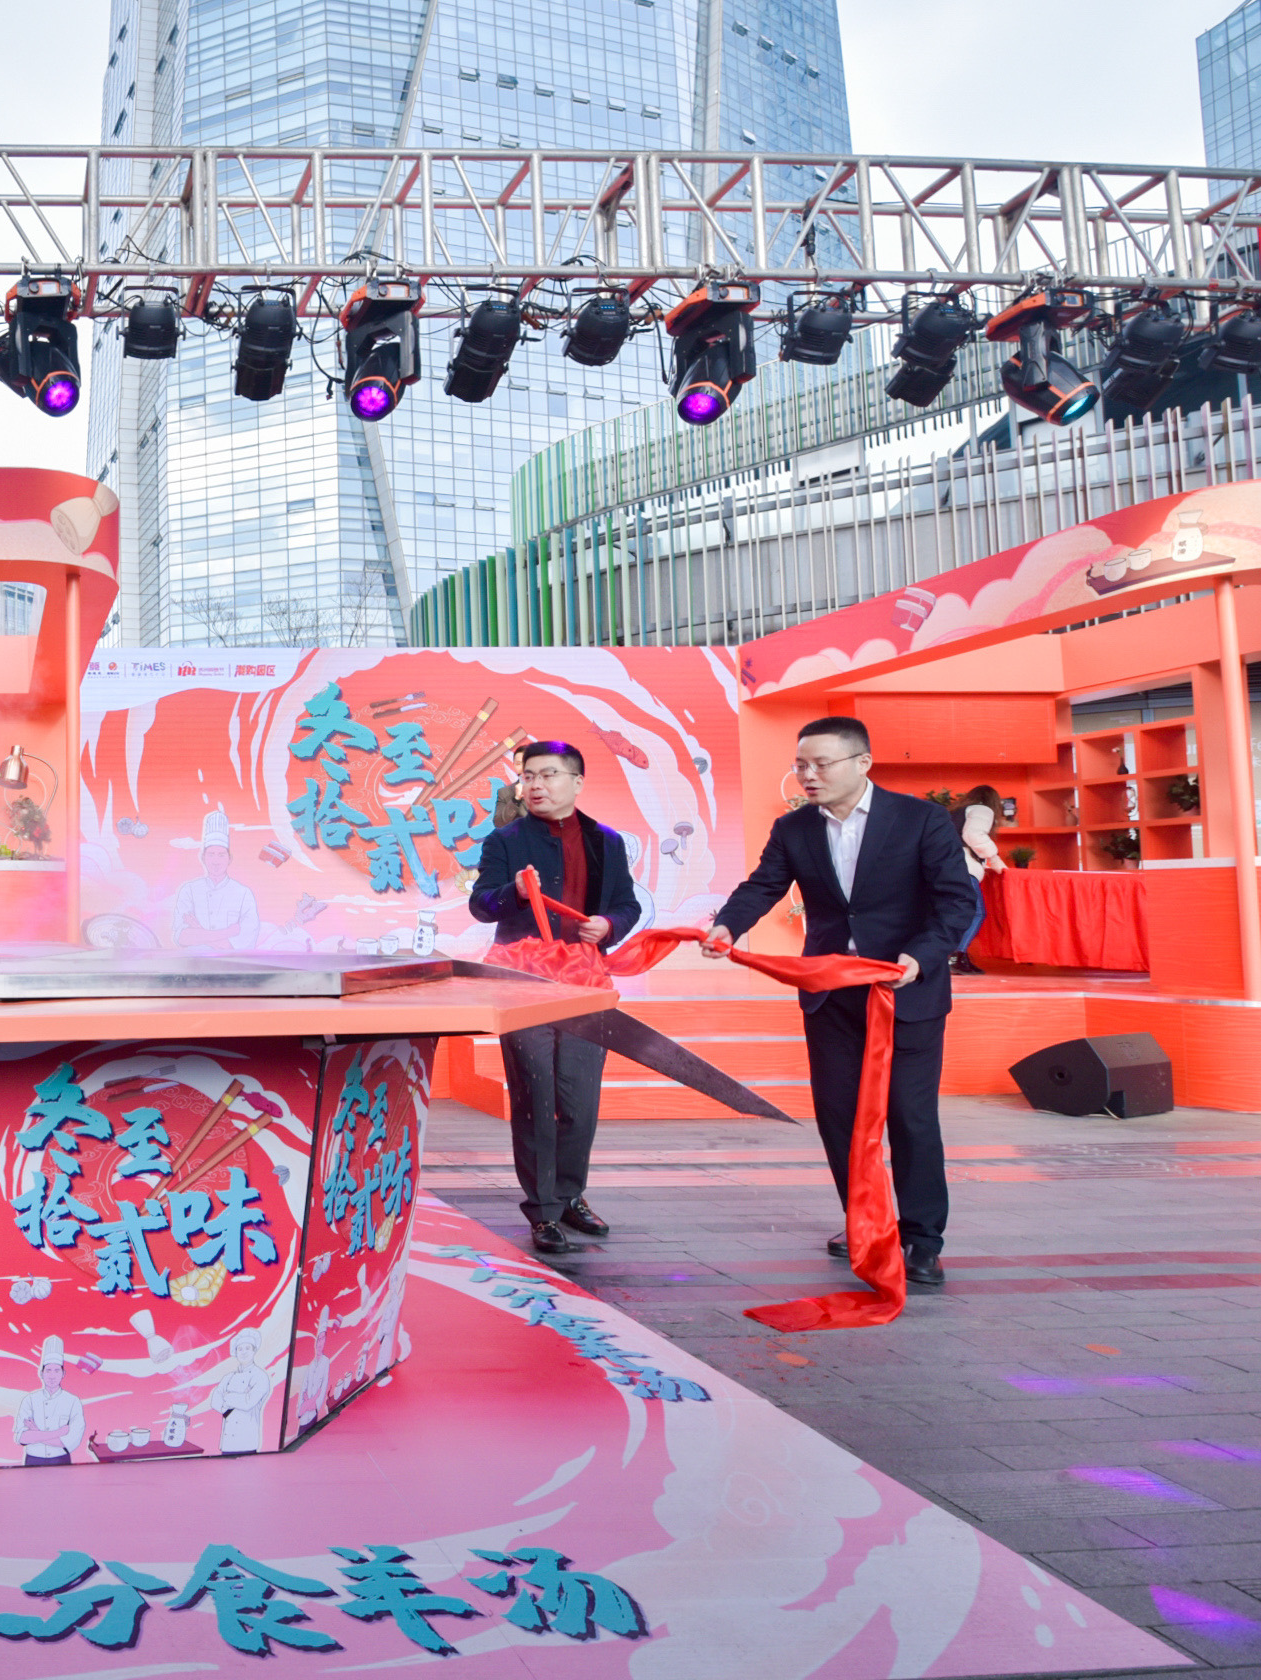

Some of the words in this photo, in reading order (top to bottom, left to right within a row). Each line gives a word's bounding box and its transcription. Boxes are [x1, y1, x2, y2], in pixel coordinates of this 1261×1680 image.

[288, 681, 437, 785] 冬至
[15, 1062, 173, 1177] 冬至
[333, 1048, 388, 1151] 冬至
